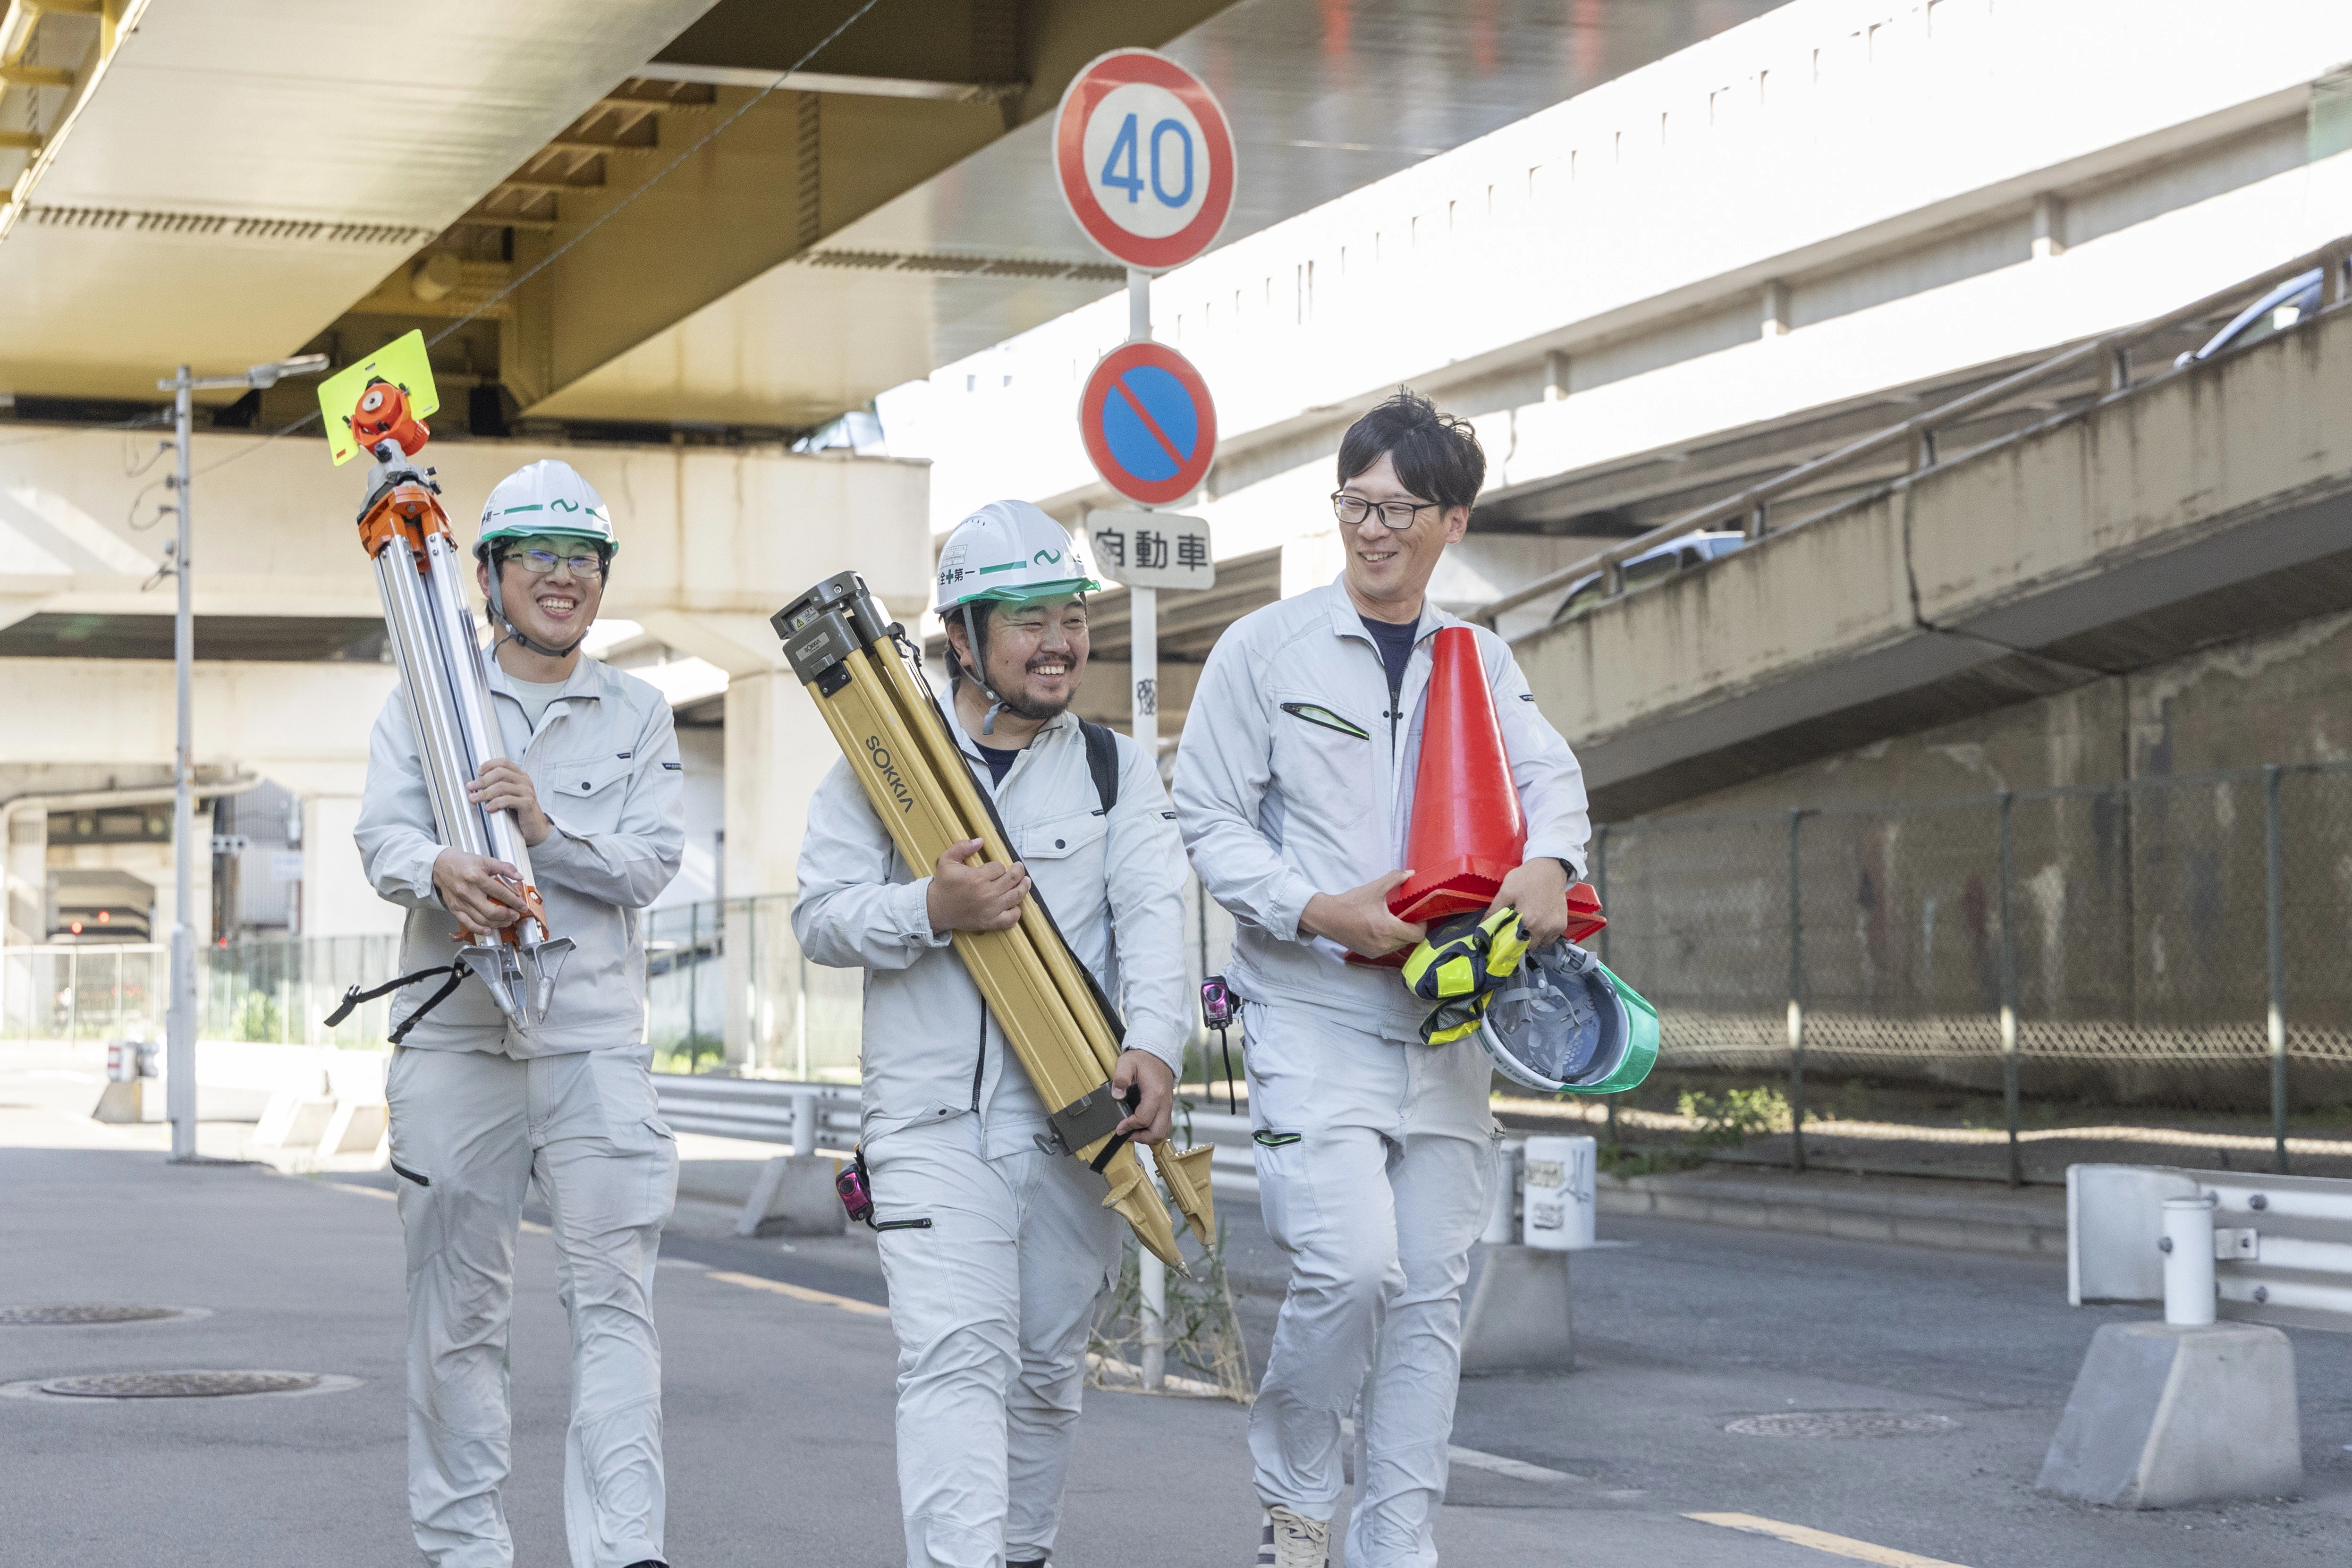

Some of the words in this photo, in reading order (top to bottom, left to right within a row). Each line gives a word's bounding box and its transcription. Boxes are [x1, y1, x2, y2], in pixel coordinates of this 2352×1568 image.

[1101, 113, 1193, 208] 40
[804, 639, 821, 653] SOKKIA
[865, 735, 914, 814] SOKKIA
